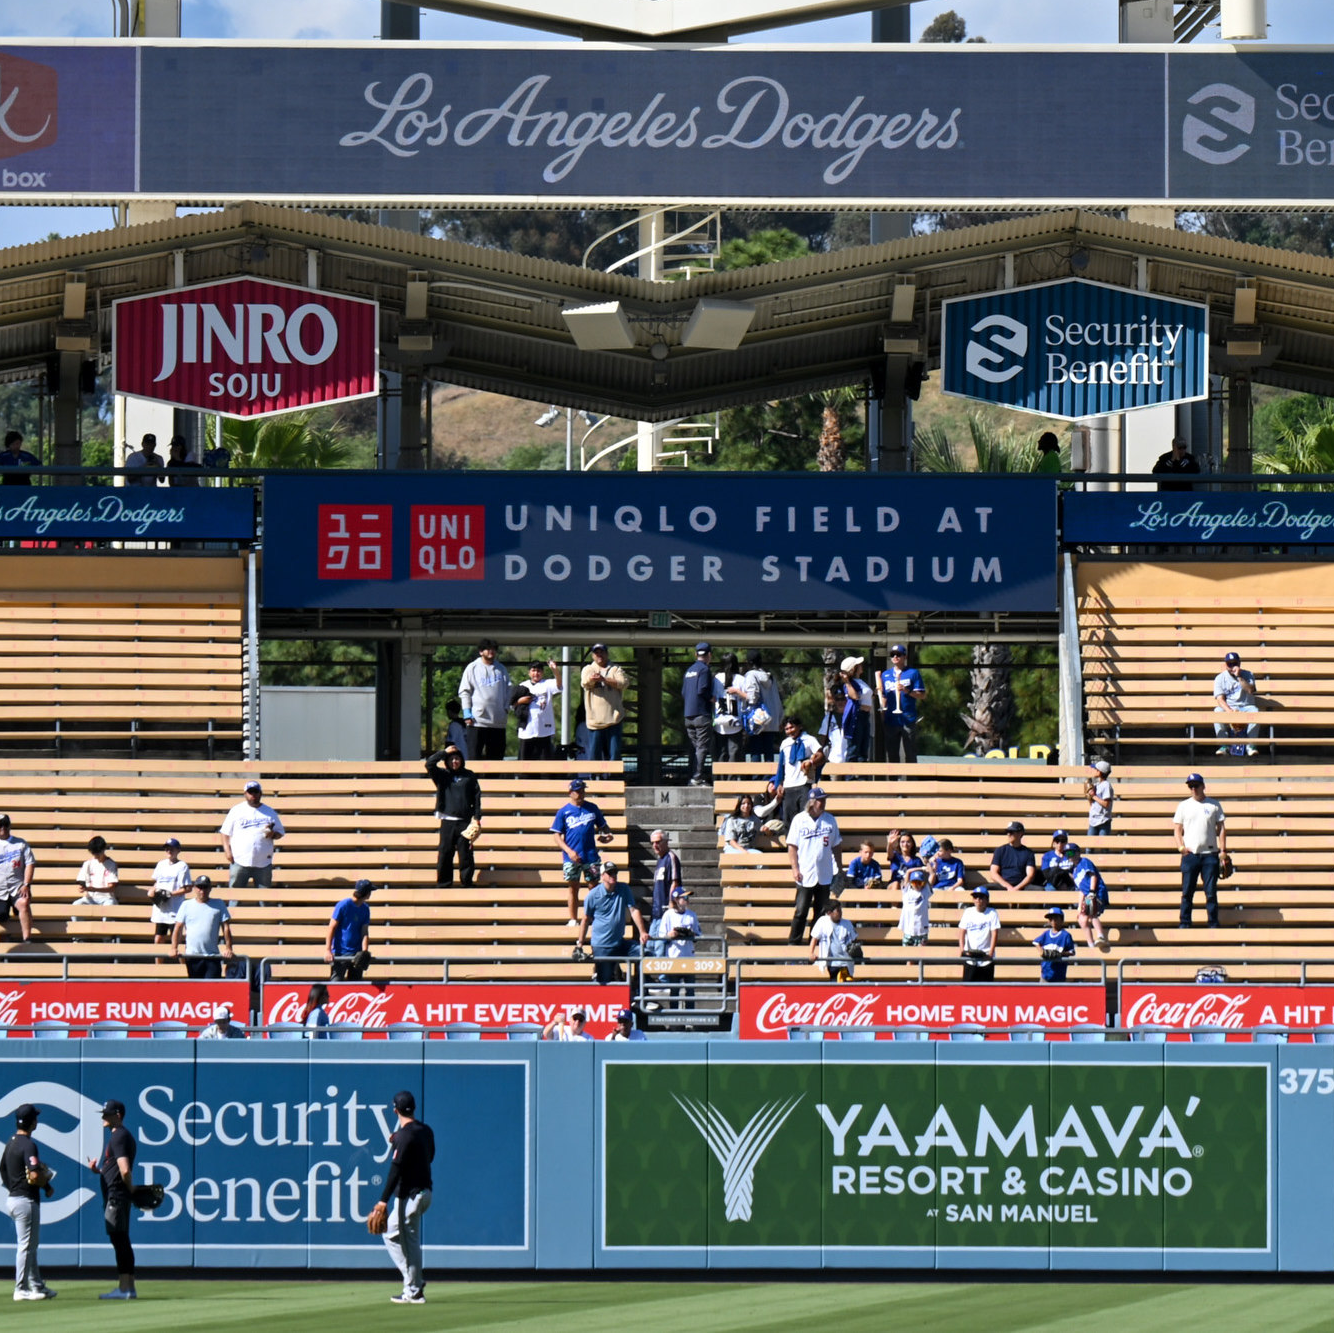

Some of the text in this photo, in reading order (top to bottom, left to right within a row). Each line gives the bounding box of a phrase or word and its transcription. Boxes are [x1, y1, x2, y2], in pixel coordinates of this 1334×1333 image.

[340, 72, 964, 185] Los Angeles Dodgers
[3, 169, 47, 188] box
[153, 303, 338, 383] JINRO
[1045, 314, 1183, 355] Security
[1045, 352, 1165, 385] Benefit
[209, 372, 282, 402] SOJU
[4, 495, 93, 534] Angeles
[92, 496, 184, 535] Dodgers
[419, 514, 472, 541] UNI
[505, 505, 995, 535] UNIQLO FIELD AT
[1130, 501, 1169, 531] Los
[1169, 501, 1257, 540] Angeles
[419, 544, 477, 574] QLO
[505, 554, 1004, 584] DODGER STADIUM
[653, 961, 715, 972] 307 309
[31, 1002, 99, 1019] HOME
[106, 1002, 153, 1019] RUN
[402, 1004, 420, 1022] A
[427, 1004, 468, 1022] HIT
[474, 1004, 558, 1023] EVERY
[756, 992, 1089, 1033] Coca-Cola HOME RUN MAGIC
[1127, 993, 1251, 1029] Coca-Cola
[1259, 1006, 1277, 1024] A
[1284, 1006, 1326, 1025] HIT
[1278, 1068, 1334, 1096] 375
[137, 1085, 402, 1164] Security
[138, 1161, 369, 1223] Benefit
[832, 1166, 1193, 1197] RESORT & CASINO
[926, 1203, 1099, 1224] AT SAN MANUEL
